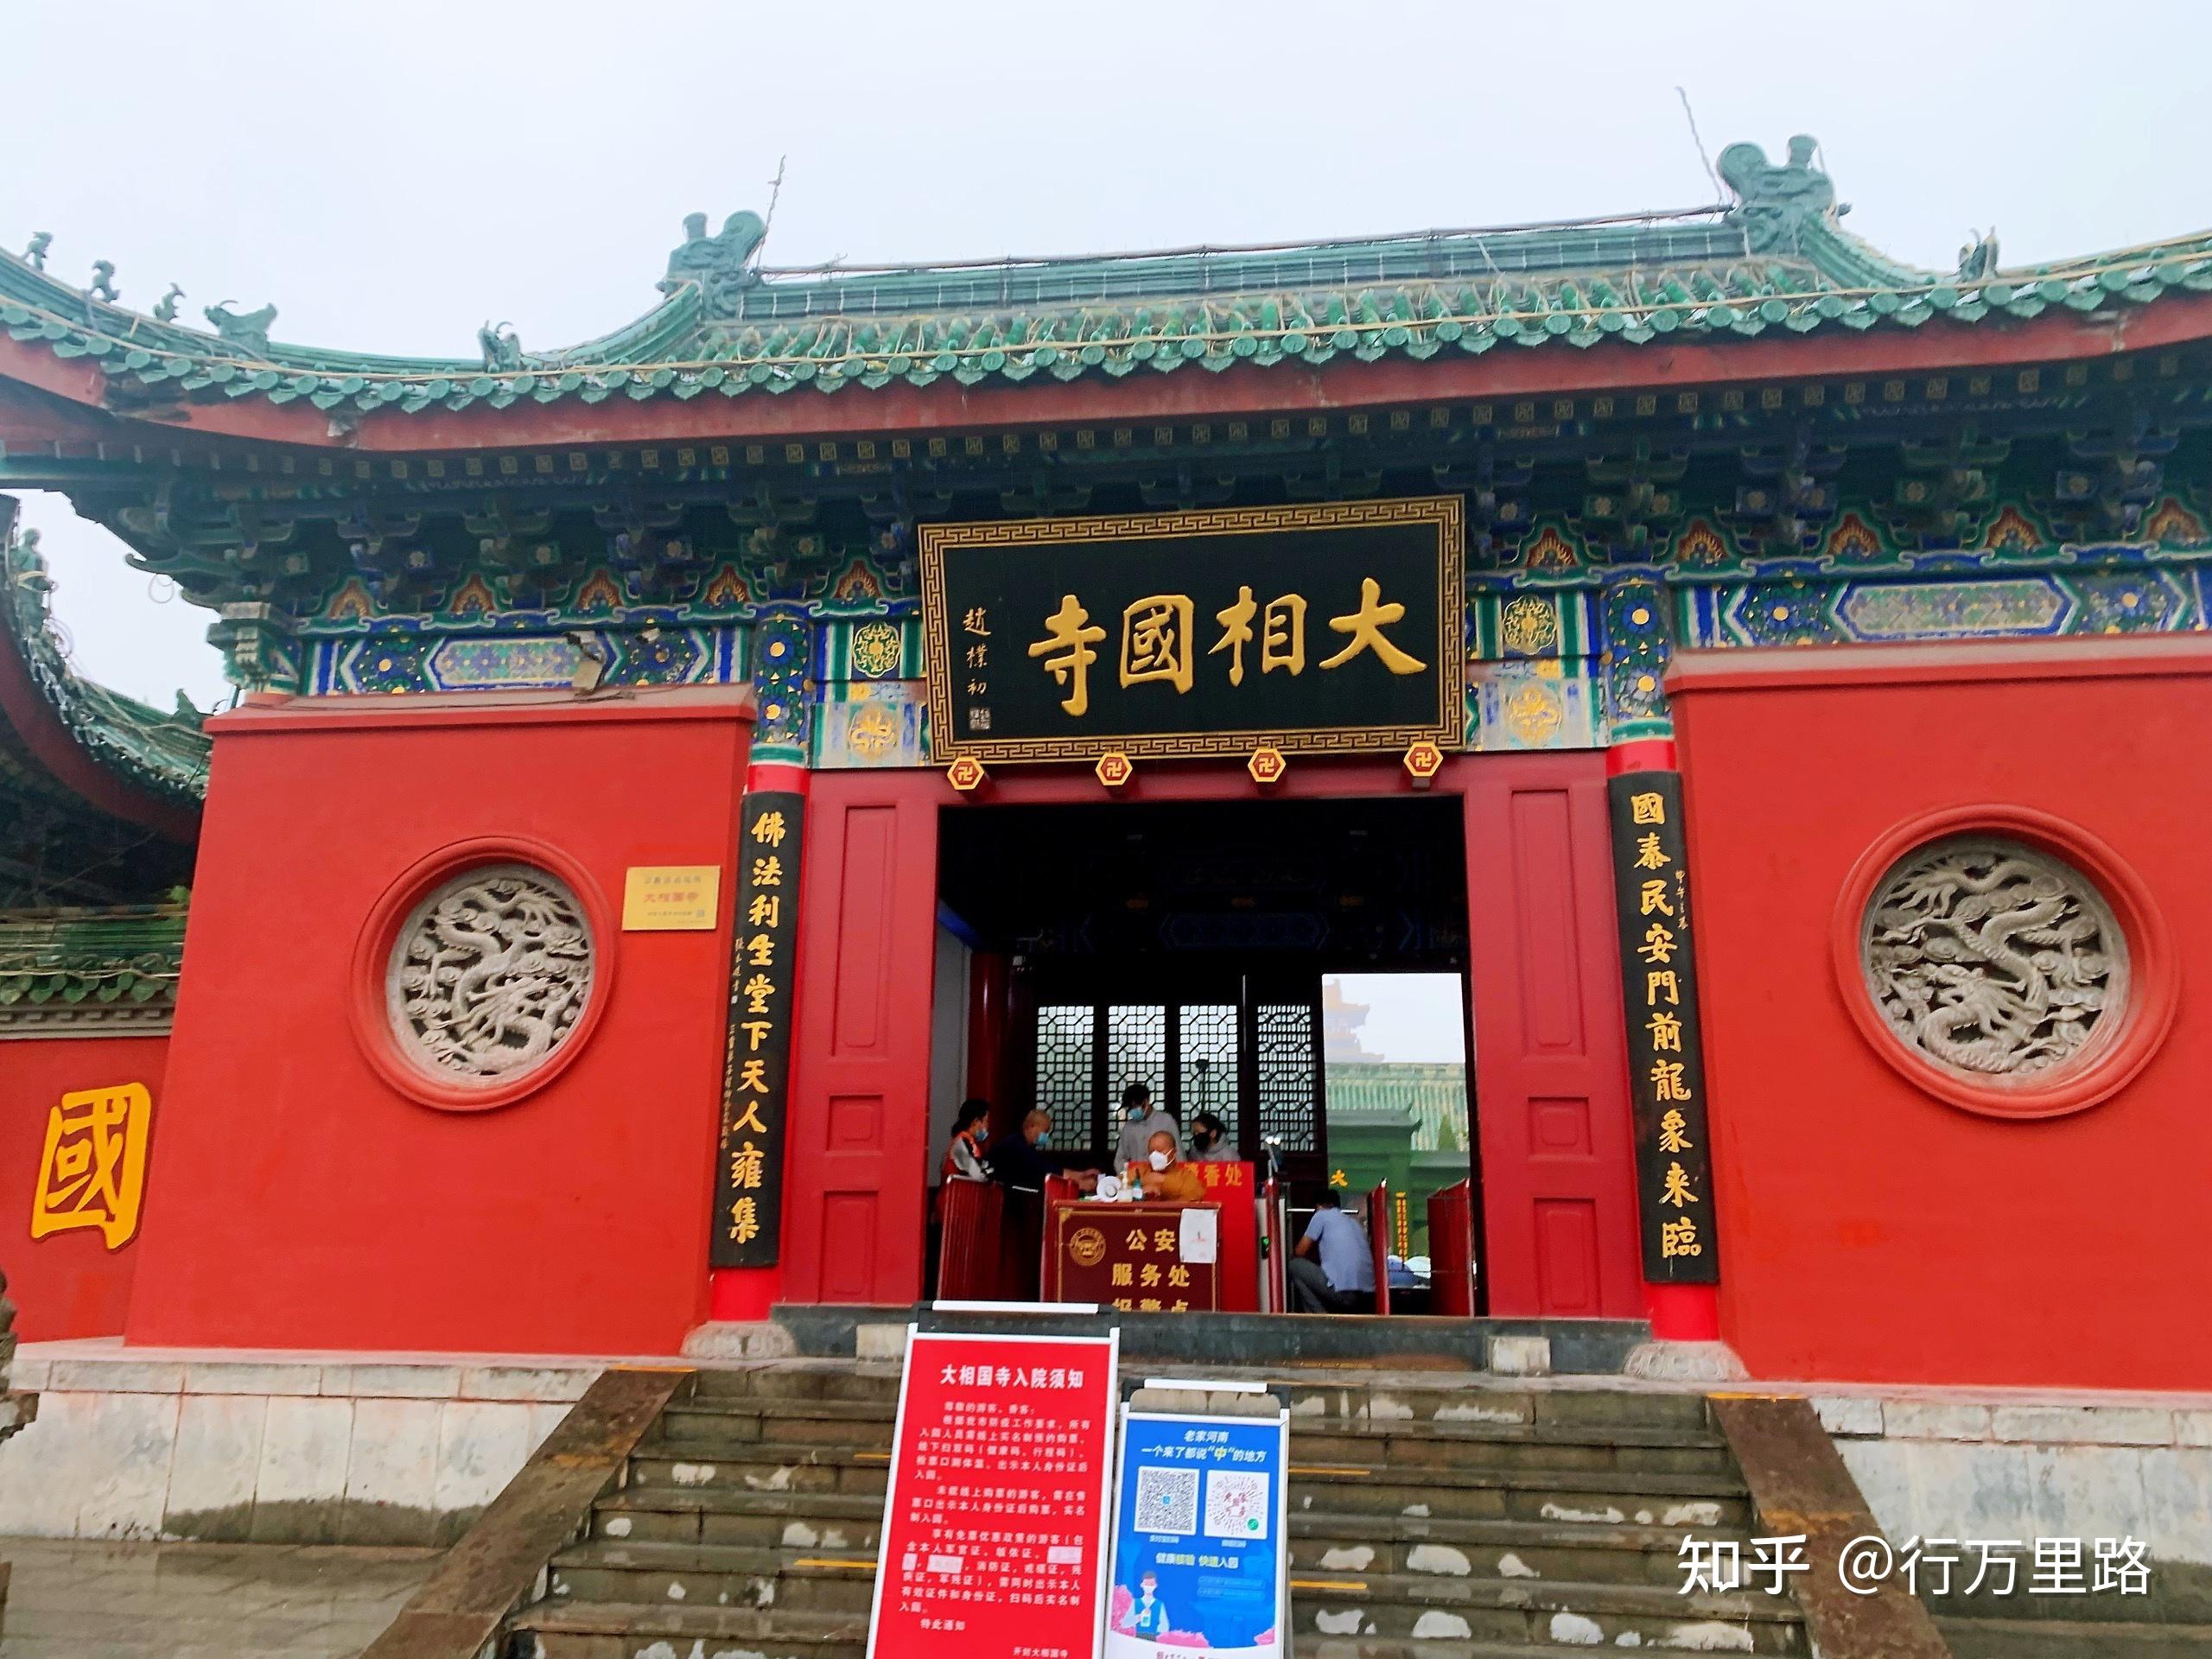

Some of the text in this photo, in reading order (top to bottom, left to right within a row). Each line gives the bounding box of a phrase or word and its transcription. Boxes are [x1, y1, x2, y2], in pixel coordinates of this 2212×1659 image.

[31, 1083, 151, 1249] 國
[1126, 1229, 1176, 1252] 公安
[1112, 1263, 1191, 1287] 服务处
[940, 1363, 1084, 1389] 大相国寺入院须知
[1184, 1430, 1229, 1444] 老家河南
